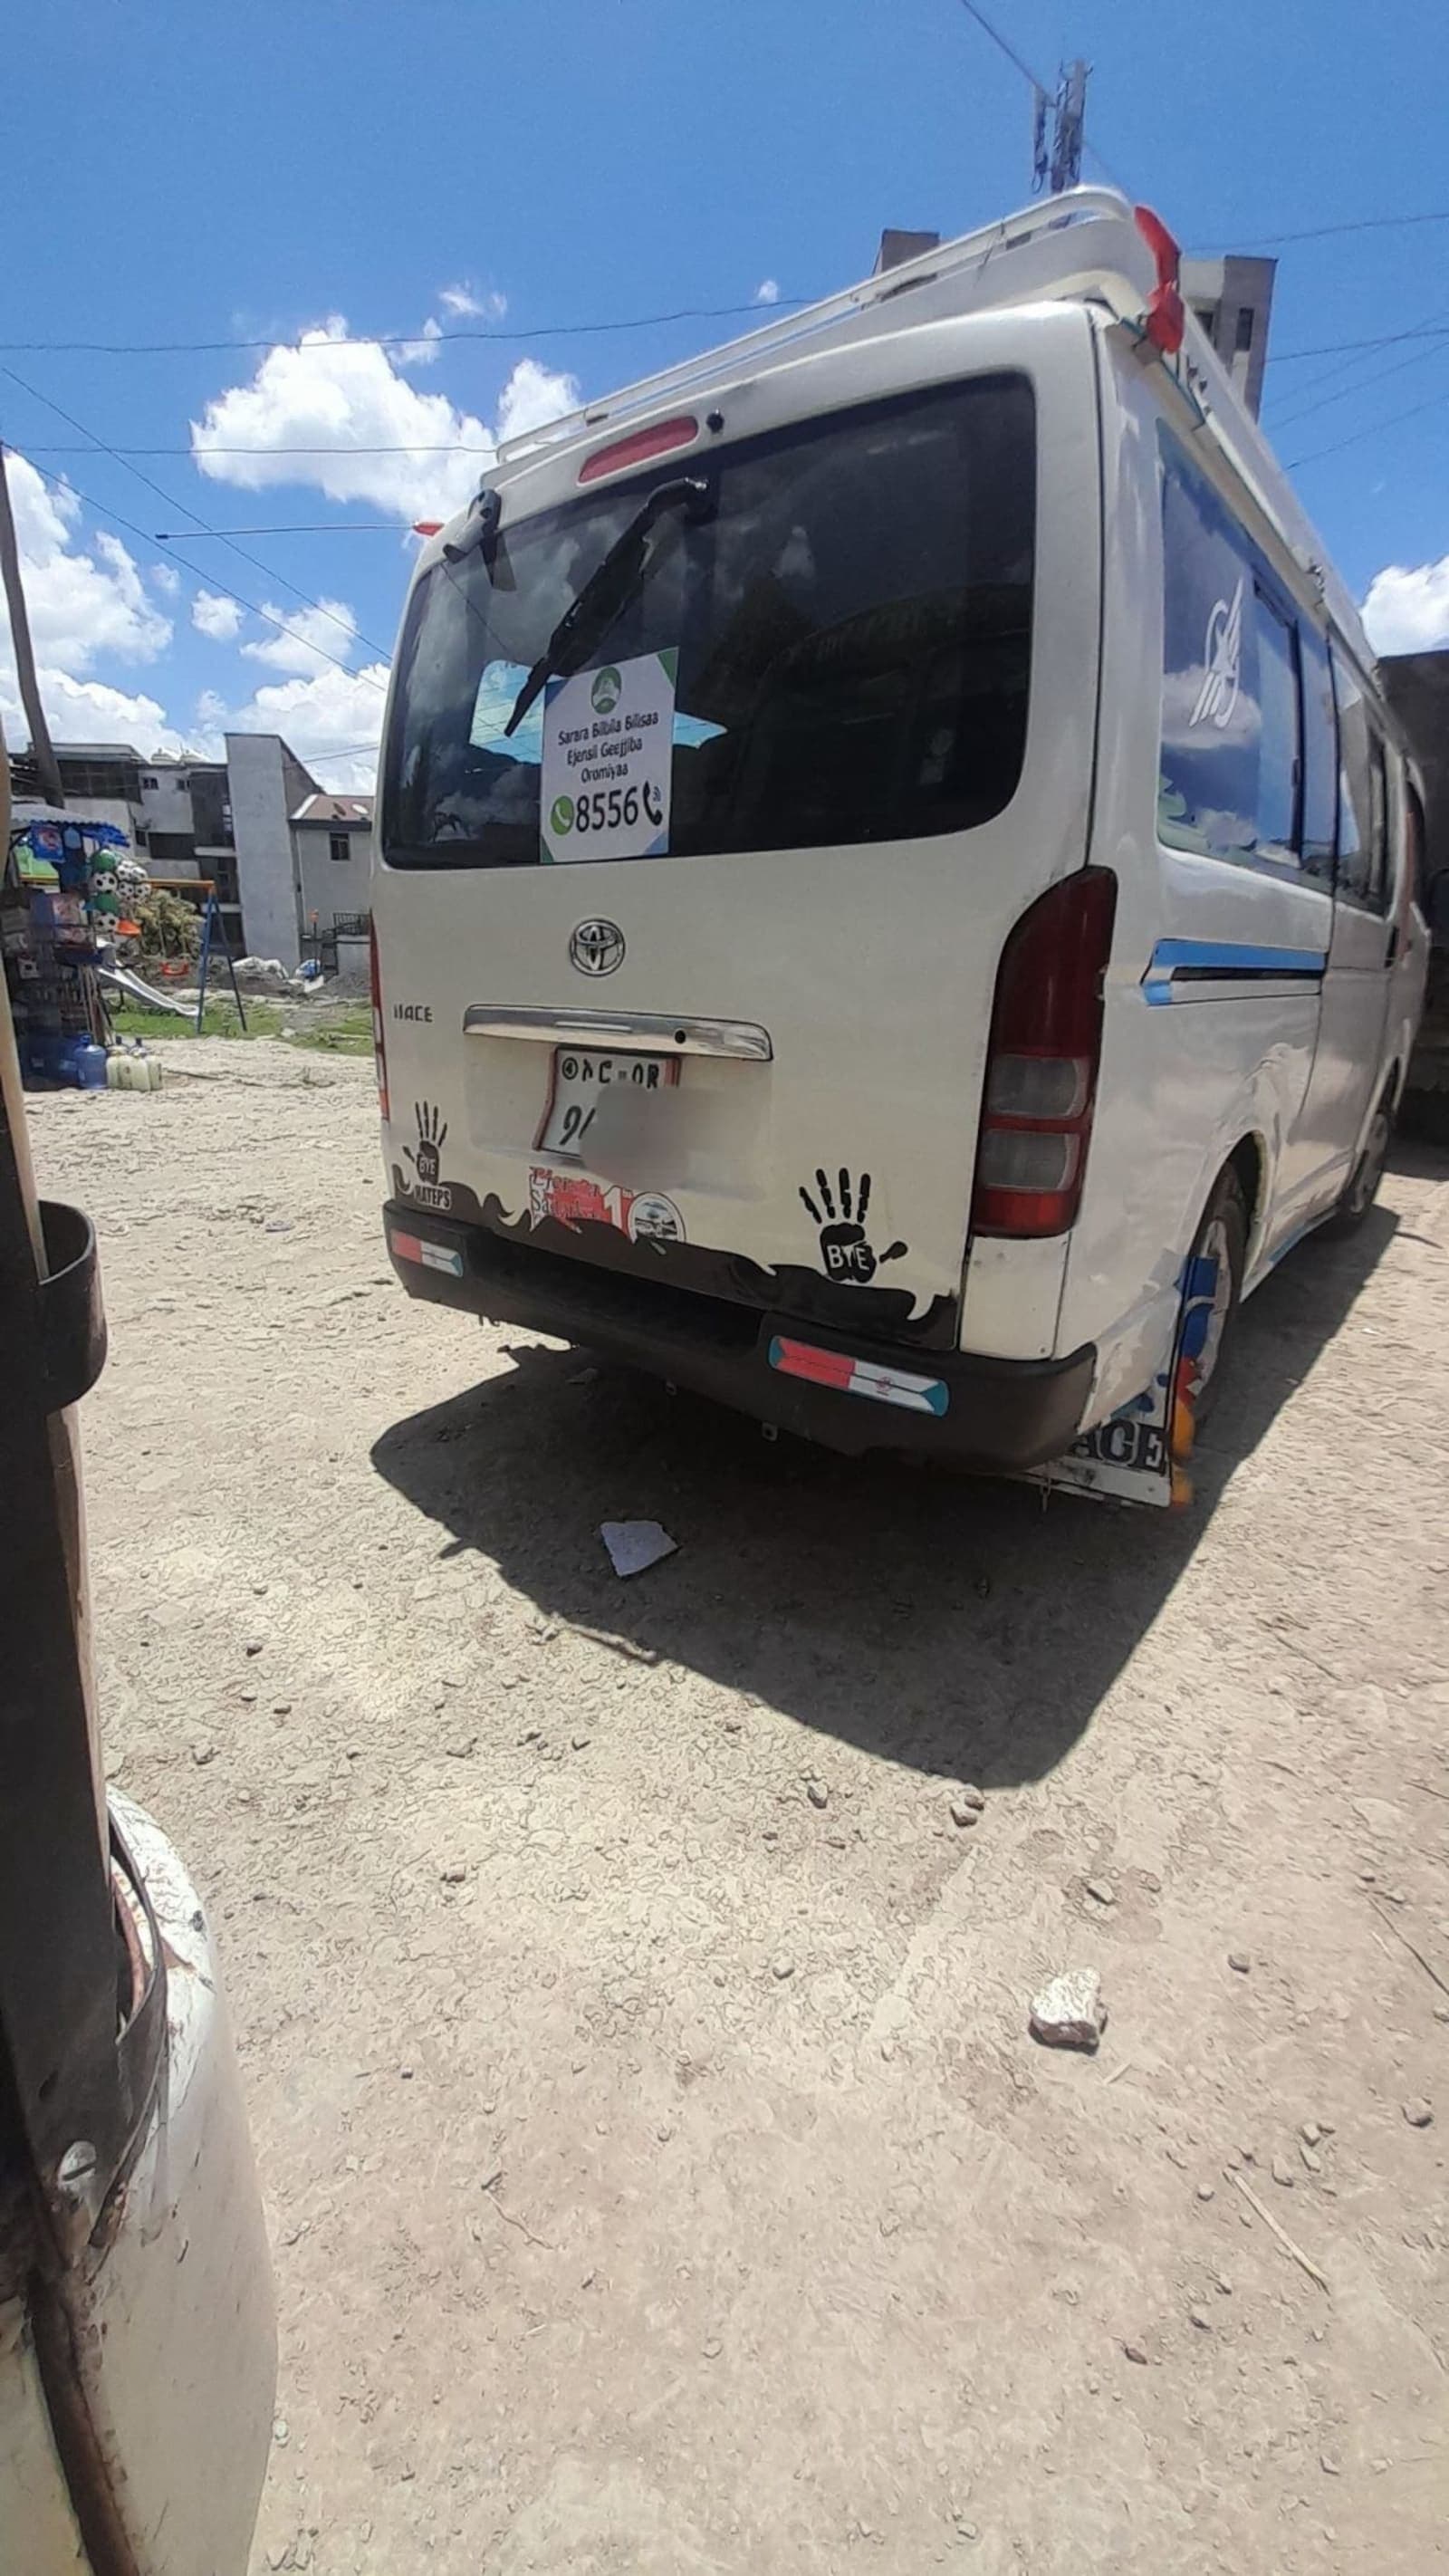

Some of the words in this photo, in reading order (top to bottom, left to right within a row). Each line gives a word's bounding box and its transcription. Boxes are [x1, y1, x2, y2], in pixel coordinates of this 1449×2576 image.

[558, 728, 589, 745] Sarara
[581, 763, 629, 783] Oromiyaa
[575, 786, 638, 832] 8556
[419, 1158, 436, 1175] BYE
[827, 1245, 870, 1271] BYE
